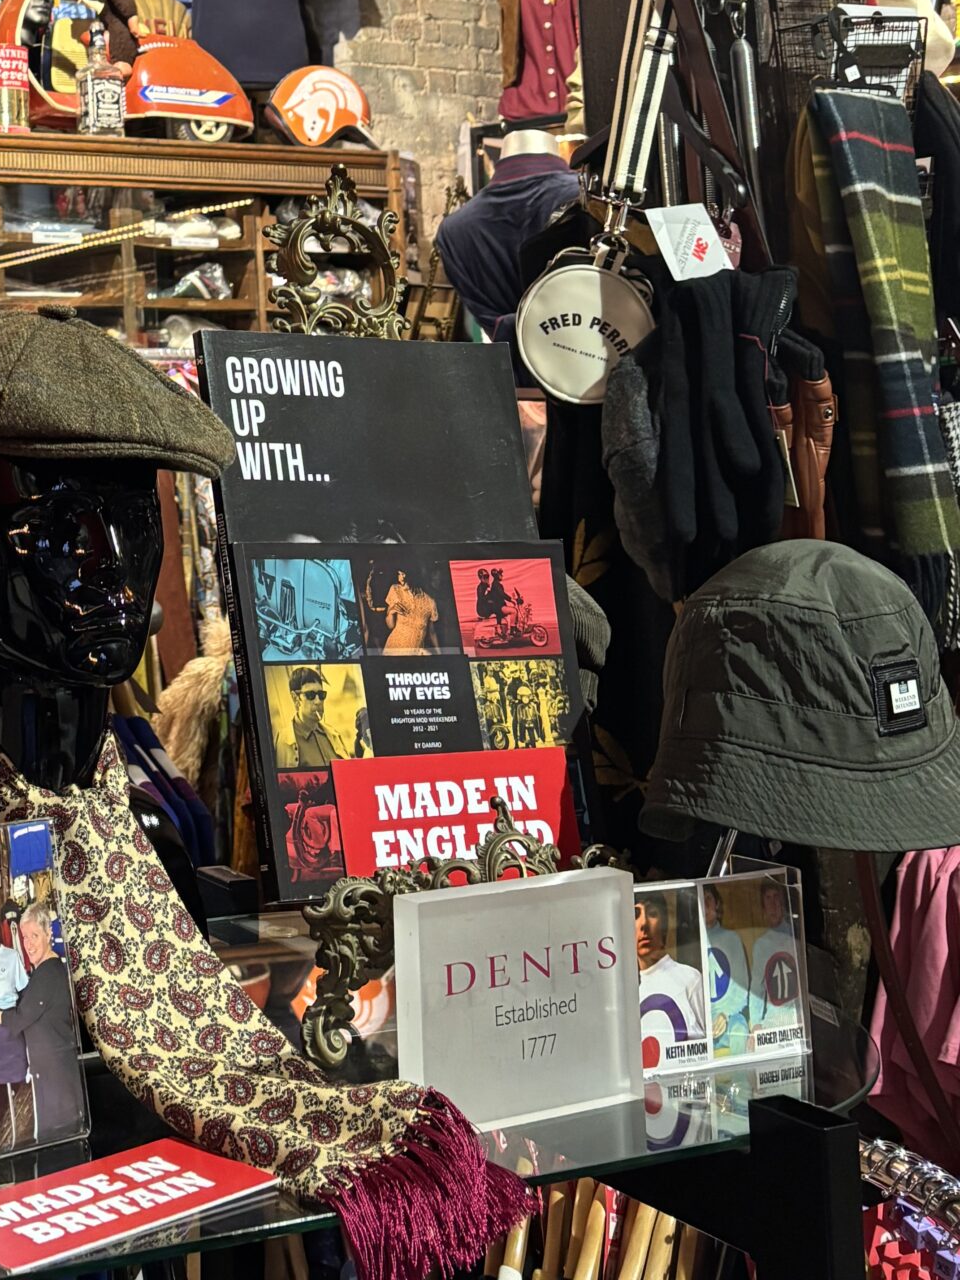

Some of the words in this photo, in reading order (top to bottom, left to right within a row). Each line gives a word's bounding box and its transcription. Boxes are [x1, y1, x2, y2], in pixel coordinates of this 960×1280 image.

[691, 237, 709, 262] 3M
[539, 313, 582, 335] FRED
[225, 356, 345, 398] GROWING
[230, 398, 266, 437] UP
[236, 442, 330, 482] WITH...
[385, 672, 449, 685] THROUGH
[389, 687, 411, 700] MY
[415, 686, 451, 700] EYES
[374, 778, 490, 821] MADE
[494, 775, 538, 811] IN
[444, 936, 617, 997] DENTS
[495, 993, 577, 1027] Established
[521, 1033, 557, 1060] 1777
[757, 1031, 778, 1046] ROGER
[779, 1027, 803, 1044] DALTREY
[666, 1045, 685, 1060] KEITH
[687, 1042, 708, 1058] MOON
[114, 1156, 181, 1183] IN
[13, 1171, 216, 1245] BRITAIN
